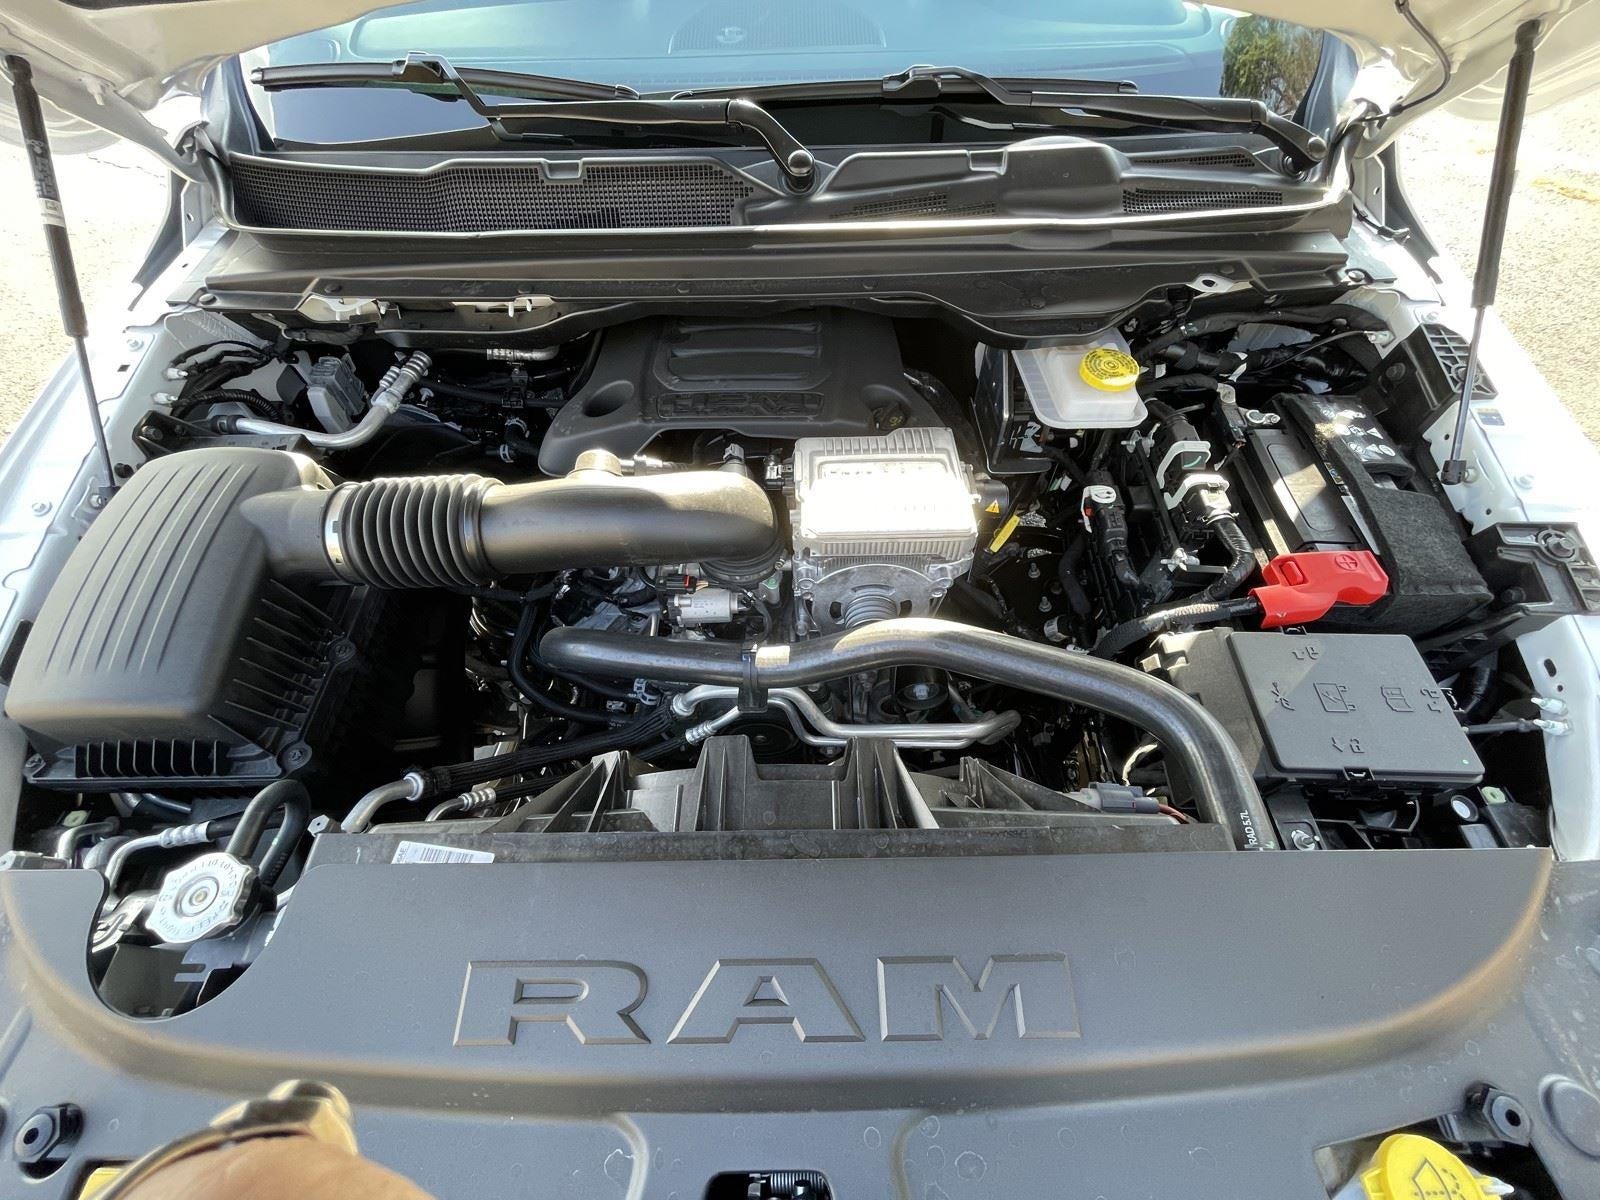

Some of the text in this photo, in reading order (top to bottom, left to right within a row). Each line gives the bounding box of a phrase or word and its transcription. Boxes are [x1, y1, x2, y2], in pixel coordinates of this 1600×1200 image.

[1240, 809, 1258, 845] RAD 5.7L
[452, 953, 1083, 1046] RAM
